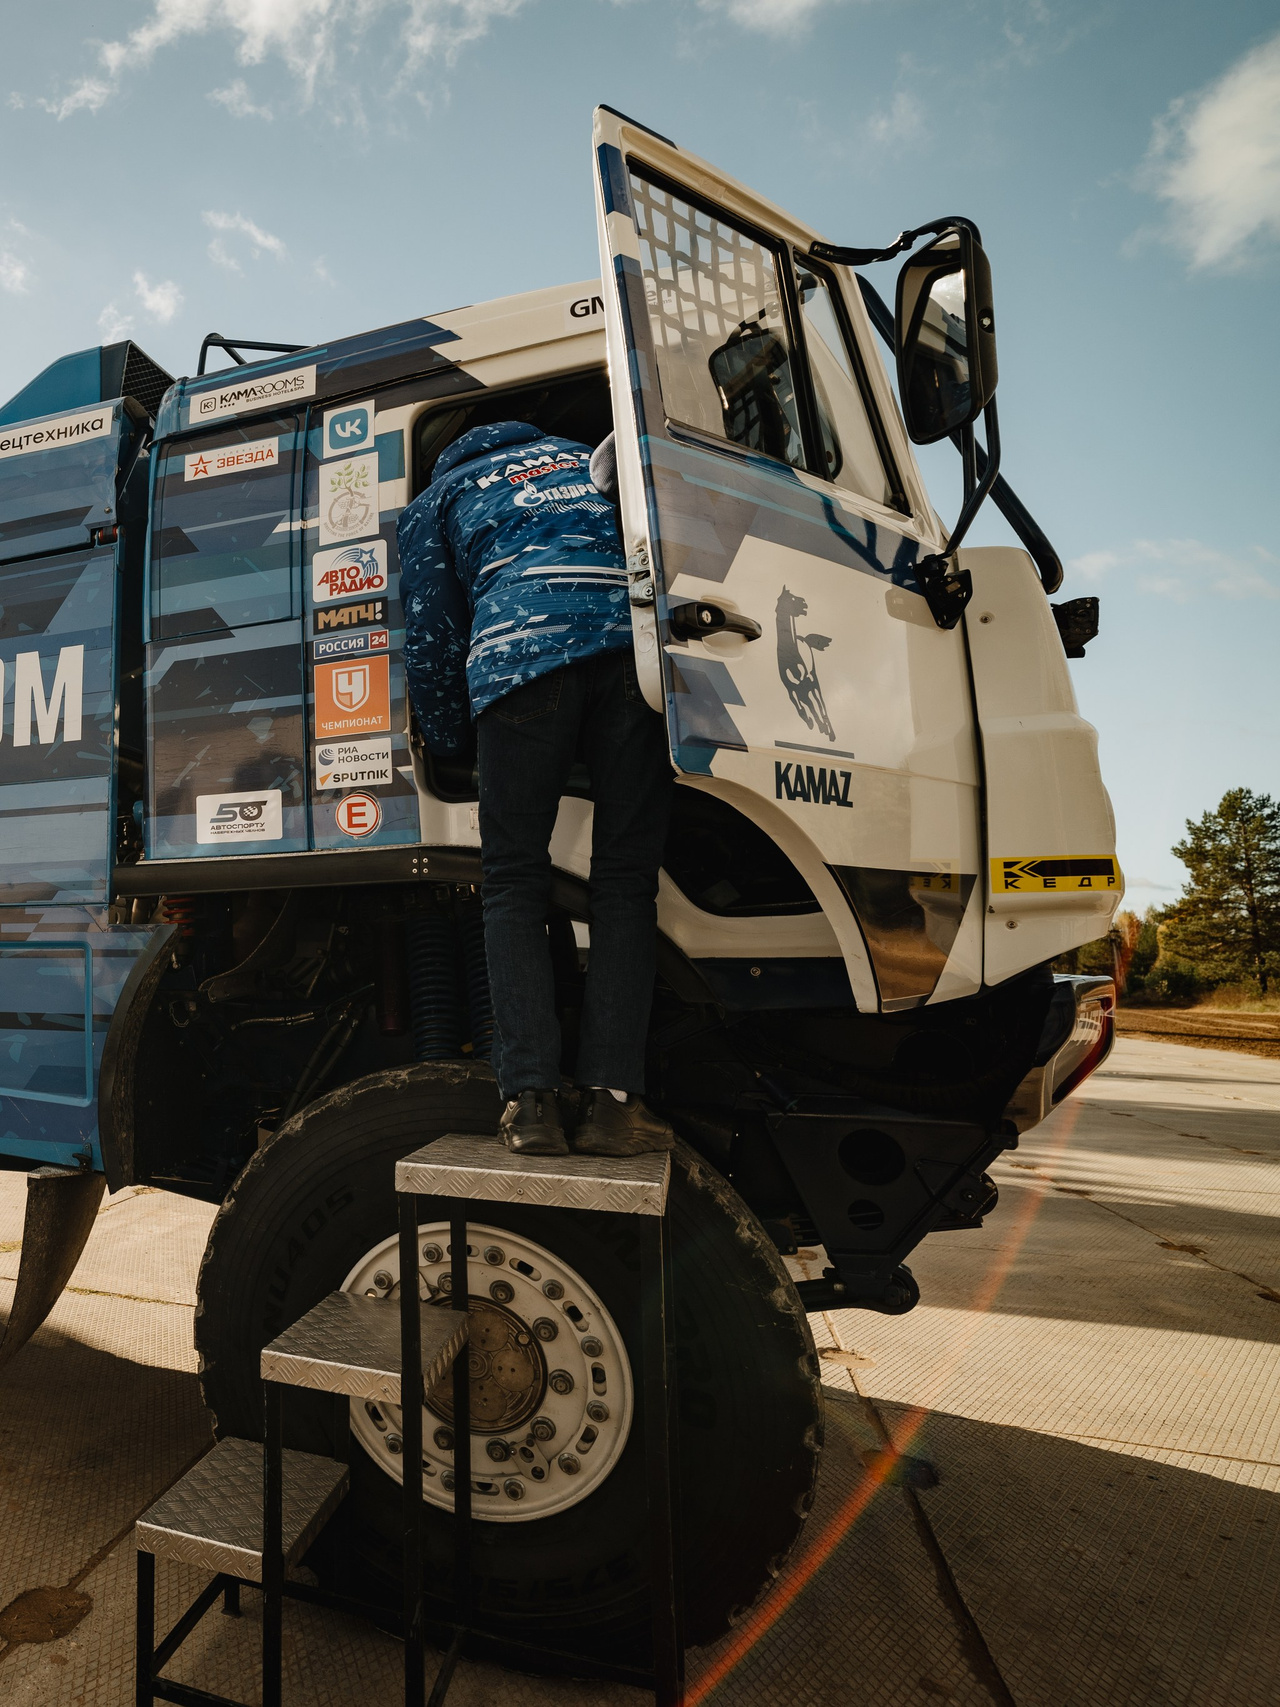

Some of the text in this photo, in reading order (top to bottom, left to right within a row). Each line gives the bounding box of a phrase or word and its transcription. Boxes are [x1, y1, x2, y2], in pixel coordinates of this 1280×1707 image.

[220, 375, 305, 403] KAMAROOMS
[217, 449, 274, 468] ЗВЕЗДА
[476, 451, 592, 490] KAMAZ
[508, 461, 580, 485] master
[544, 483, 599, 501] ГАЗПРО
[317, 566, 360, 586] АВТО
[329, 574, 384, 596] РАДИО
[317, 601, 382, 630] МАТЧ!
[319, 633, 387, 654] РОССИЯ 24
[321, 715, 383, 731] ЧЕМПИОНАТ
[338, 746, 358, 755] РИА
[338, 752, 389, 764] НОВОСТИ
[333, 769, 389, 783] SPUTNIK
[775, 761, 853, 808] KAMAZ
[210, 800, 268, 823] 50
[347, 802, 367, 828] E
[211, 822, 266, 831] АВТОСПОРТУ
[1004, 876, 1116, 889] КЕДР
